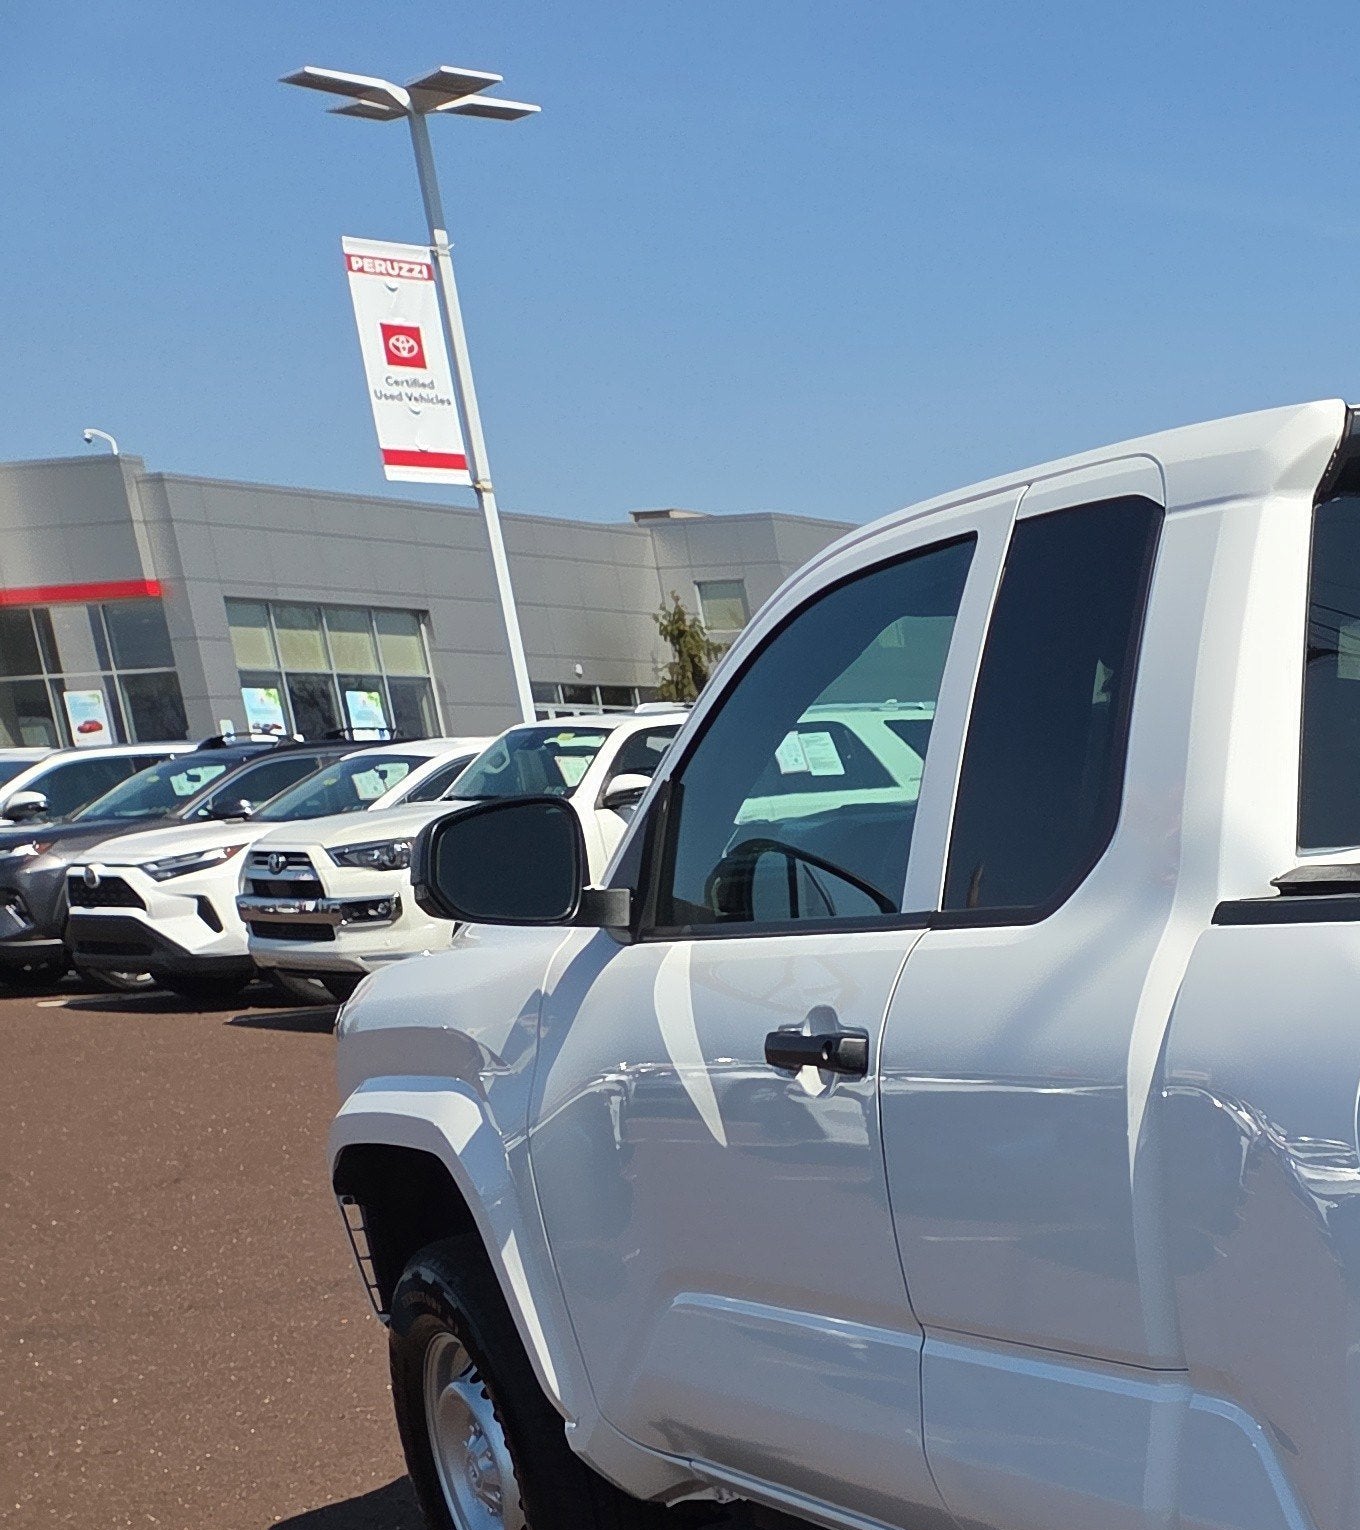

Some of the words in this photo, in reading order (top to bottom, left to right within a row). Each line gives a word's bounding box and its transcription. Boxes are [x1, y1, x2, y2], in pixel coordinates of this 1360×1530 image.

[351, 256, 428, 278] PERUZZI
[385, 375, 435, 390] Certified
[374, 389, 403, 402] Used
[405, 392, 452, 406] Vehicles
